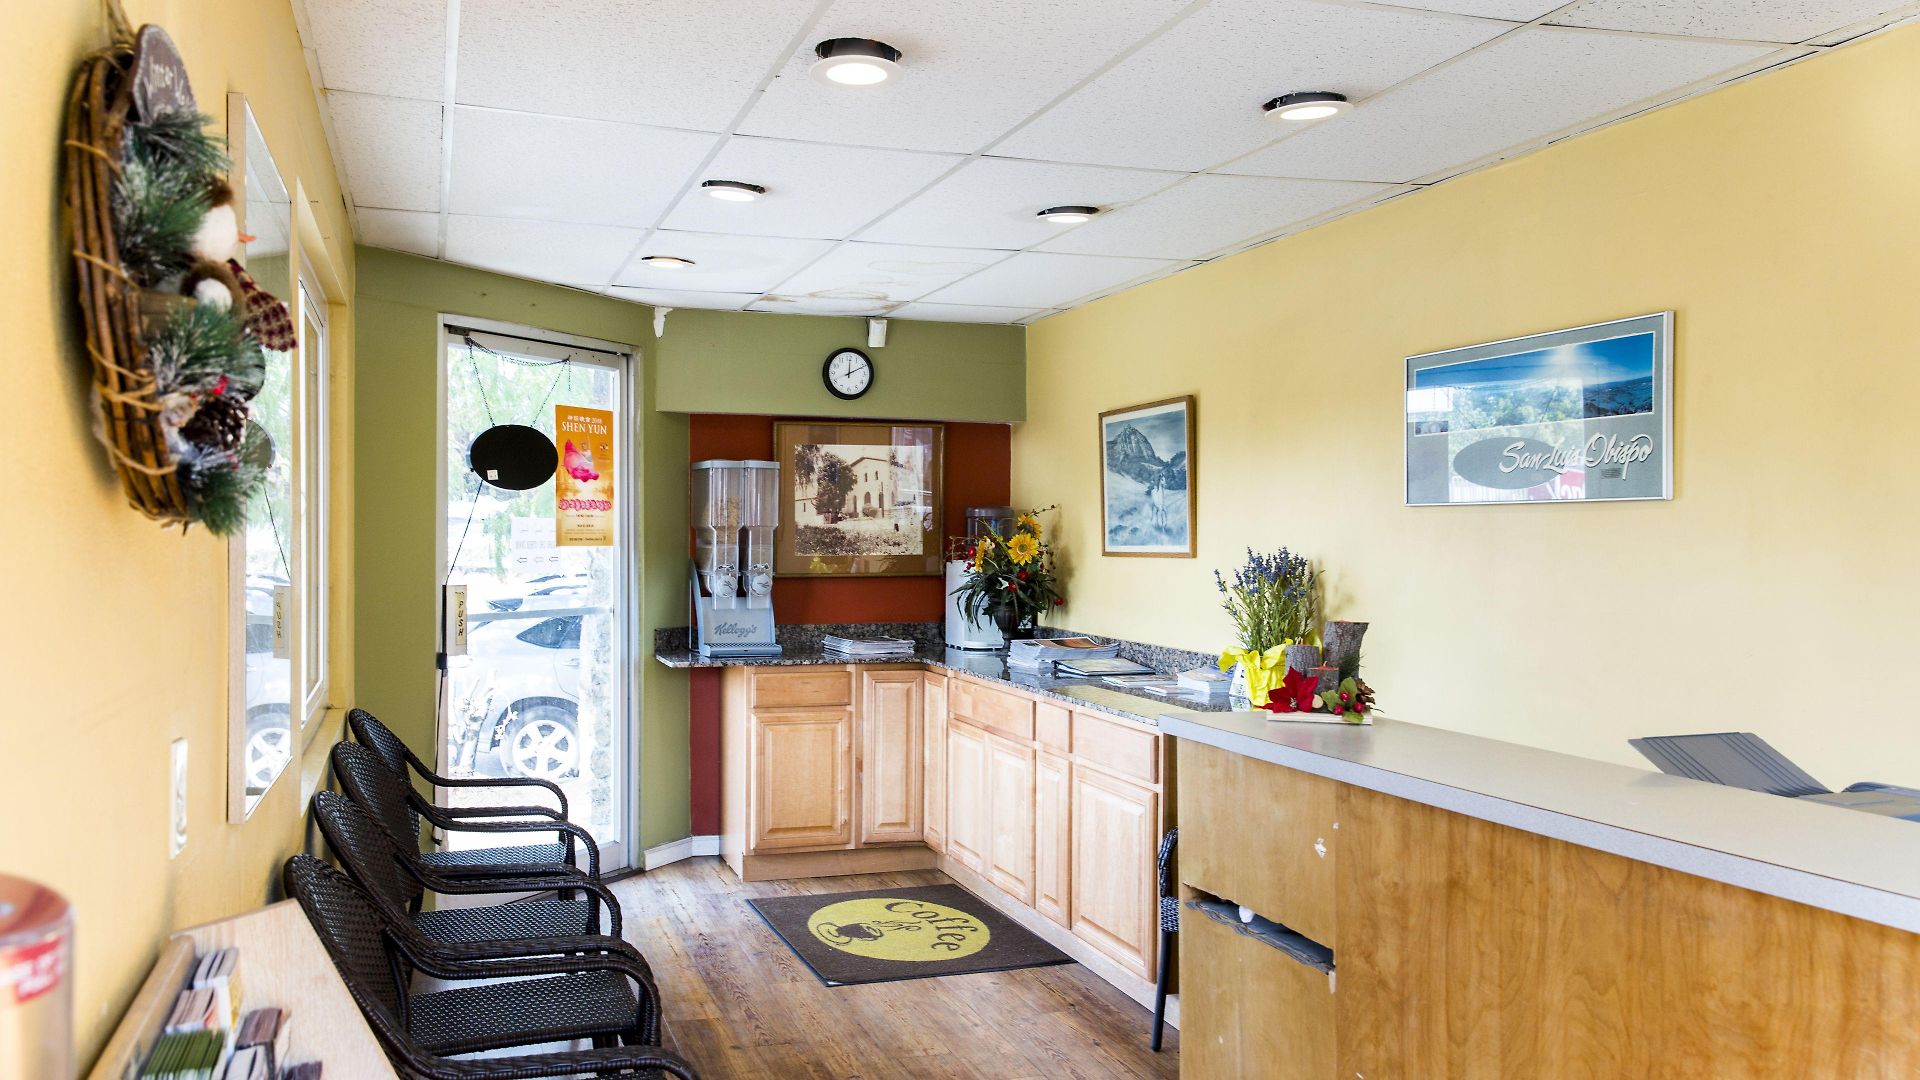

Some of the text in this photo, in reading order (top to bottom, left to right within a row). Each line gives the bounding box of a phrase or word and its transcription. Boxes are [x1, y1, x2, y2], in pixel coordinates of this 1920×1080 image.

[561, 421, 608, 436] SHEN YUN
[1499, 432, 1654, 481] San Luis Obispo
[714, 621, 758, 638] Kellogg's
[885, 901, 978, 951] Coffee
